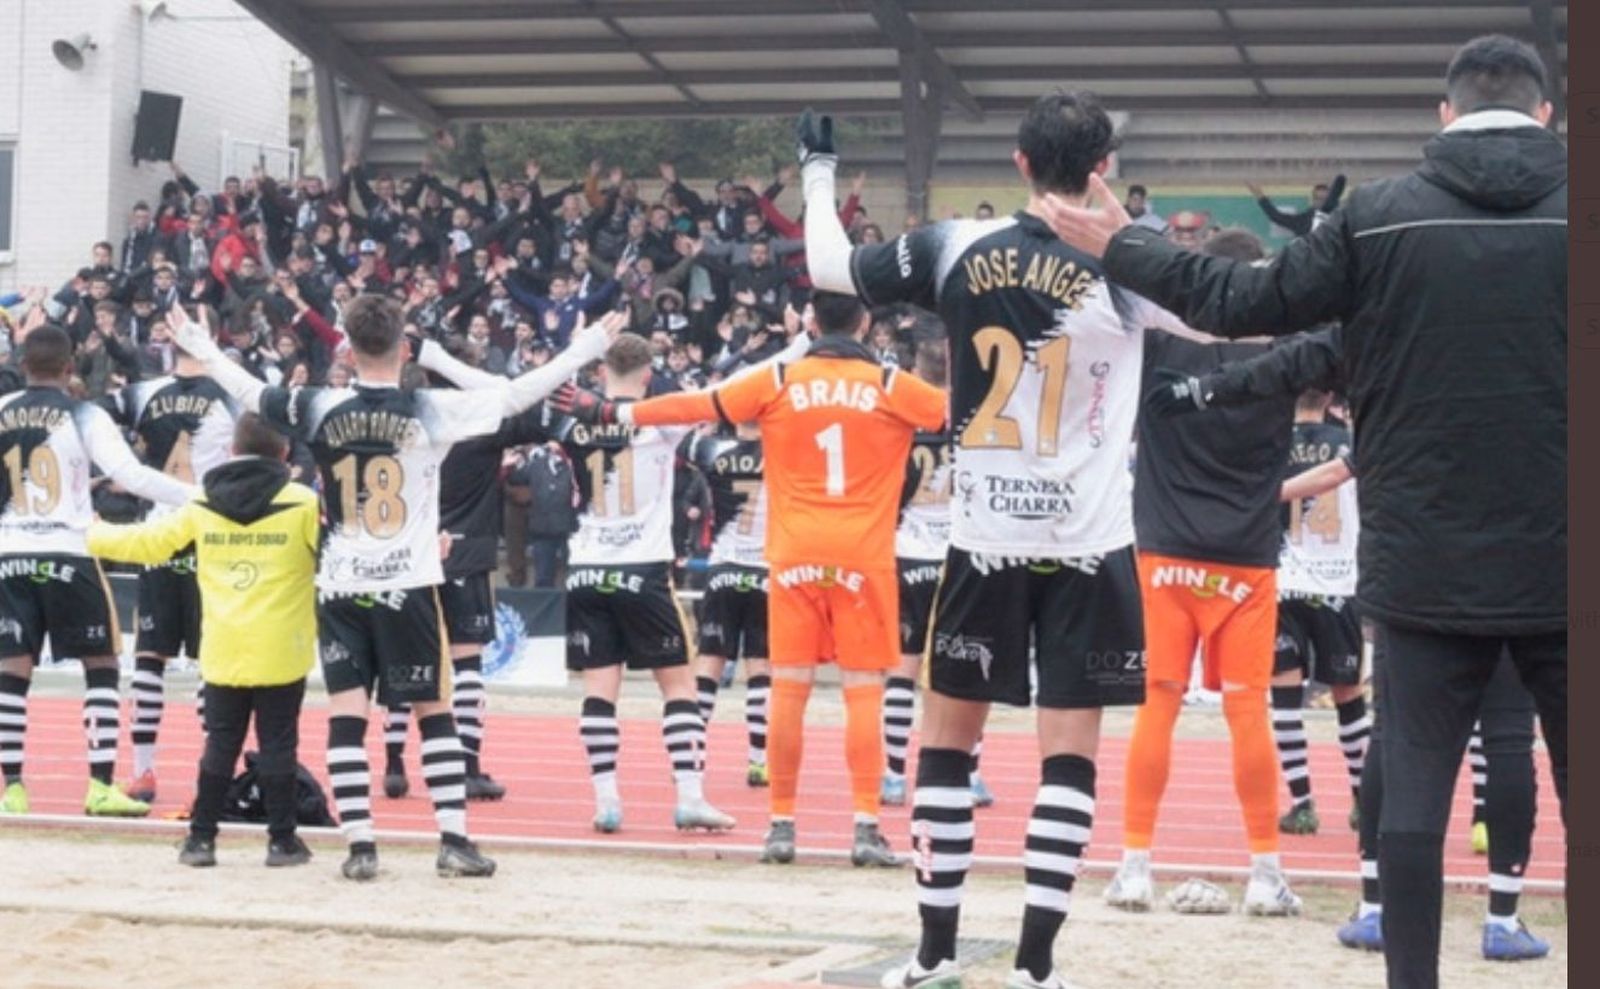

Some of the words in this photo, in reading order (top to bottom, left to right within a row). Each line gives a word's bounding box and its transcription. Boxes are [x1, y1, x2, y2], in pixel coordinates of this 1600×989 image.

[964, 248, 1019, 296] JOSE
[788, 379, 878, 413] BRAIS
[960, 325, 1072, 457] 21
[3, 443, 62, 516] 19
[586, 448, 636, 518] 11
[814, 422, 845, 496] 1
[331, 453, 408, 539] 18
[731, 479, 764, 535] 7
[989, 493, 1073, 514] CHARRA
[566, 568, 644, 594] WINGLE
